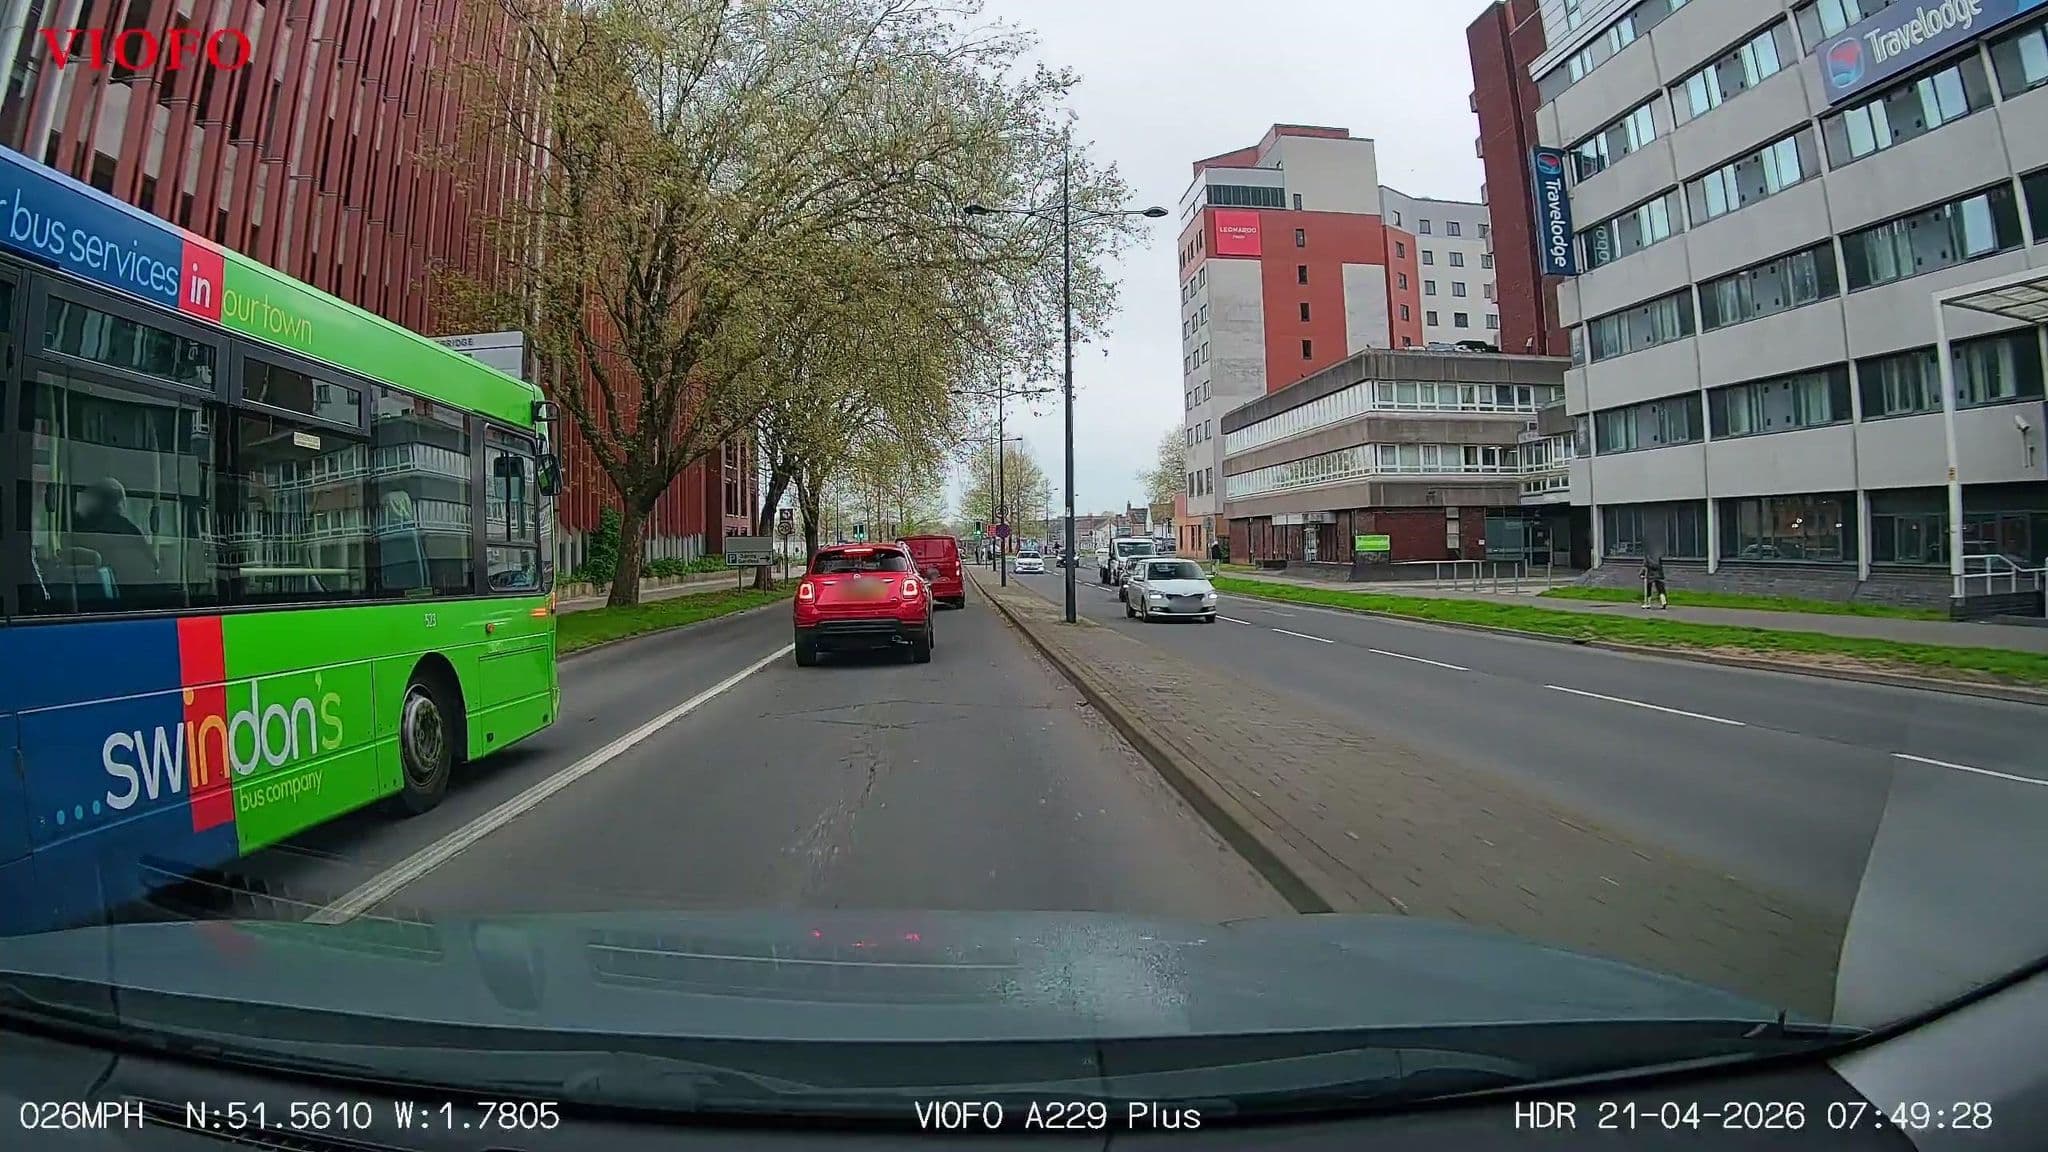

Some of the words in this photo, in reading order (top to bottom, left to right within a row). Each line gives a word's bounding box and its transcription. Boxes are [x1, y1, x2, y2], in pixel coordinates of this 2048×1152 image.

[1864, 0, 1983, 64] Travelodge
[10, 188, 66, 255] bus
[69, 229, 179, 296] services
[190, 262, 211, 309] in
[223, 289, 259, 325] our
[260, 294, 312, 344] town
[1545, 178, 1568, 267] Travelodge
[102, 671, 344, 810] swindon's
[240, 786, 265, 812] bus
[266, 769, 324, 804] company
